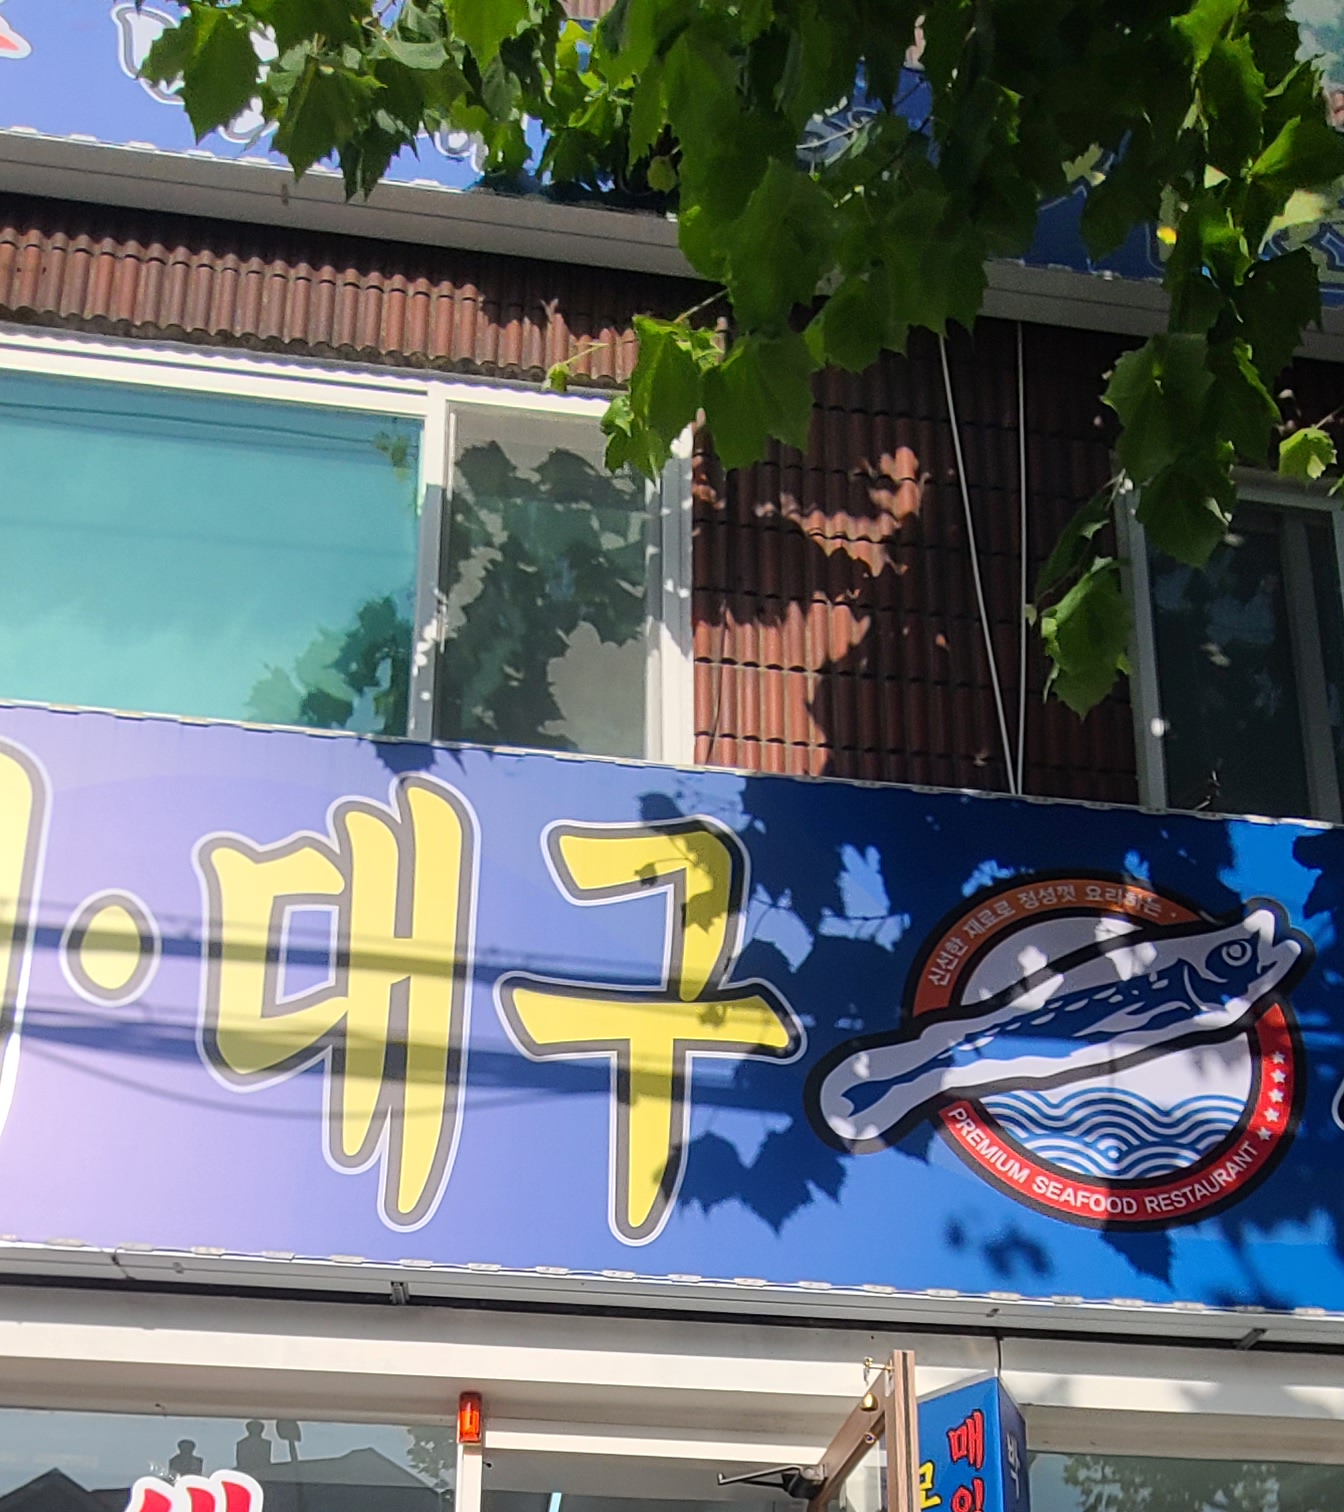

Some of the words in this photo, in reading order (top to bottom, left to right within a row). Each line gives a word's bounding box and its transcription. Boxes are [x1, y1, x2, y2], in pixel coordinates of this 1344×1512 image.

[926, 936, 965, 988] 신선한
[965, 898, 1015, 941] 재료로
[1017, 883, 1077, 913] 정성껏
[1084, 883, 1164, 915] 요리하는
[946, 1106, 1029, 1184] PREMIUM
[1031, 1175, 1138, 1216] SEAFOOD
[1143, 1142, 1260, 1214] RESTAURANT
